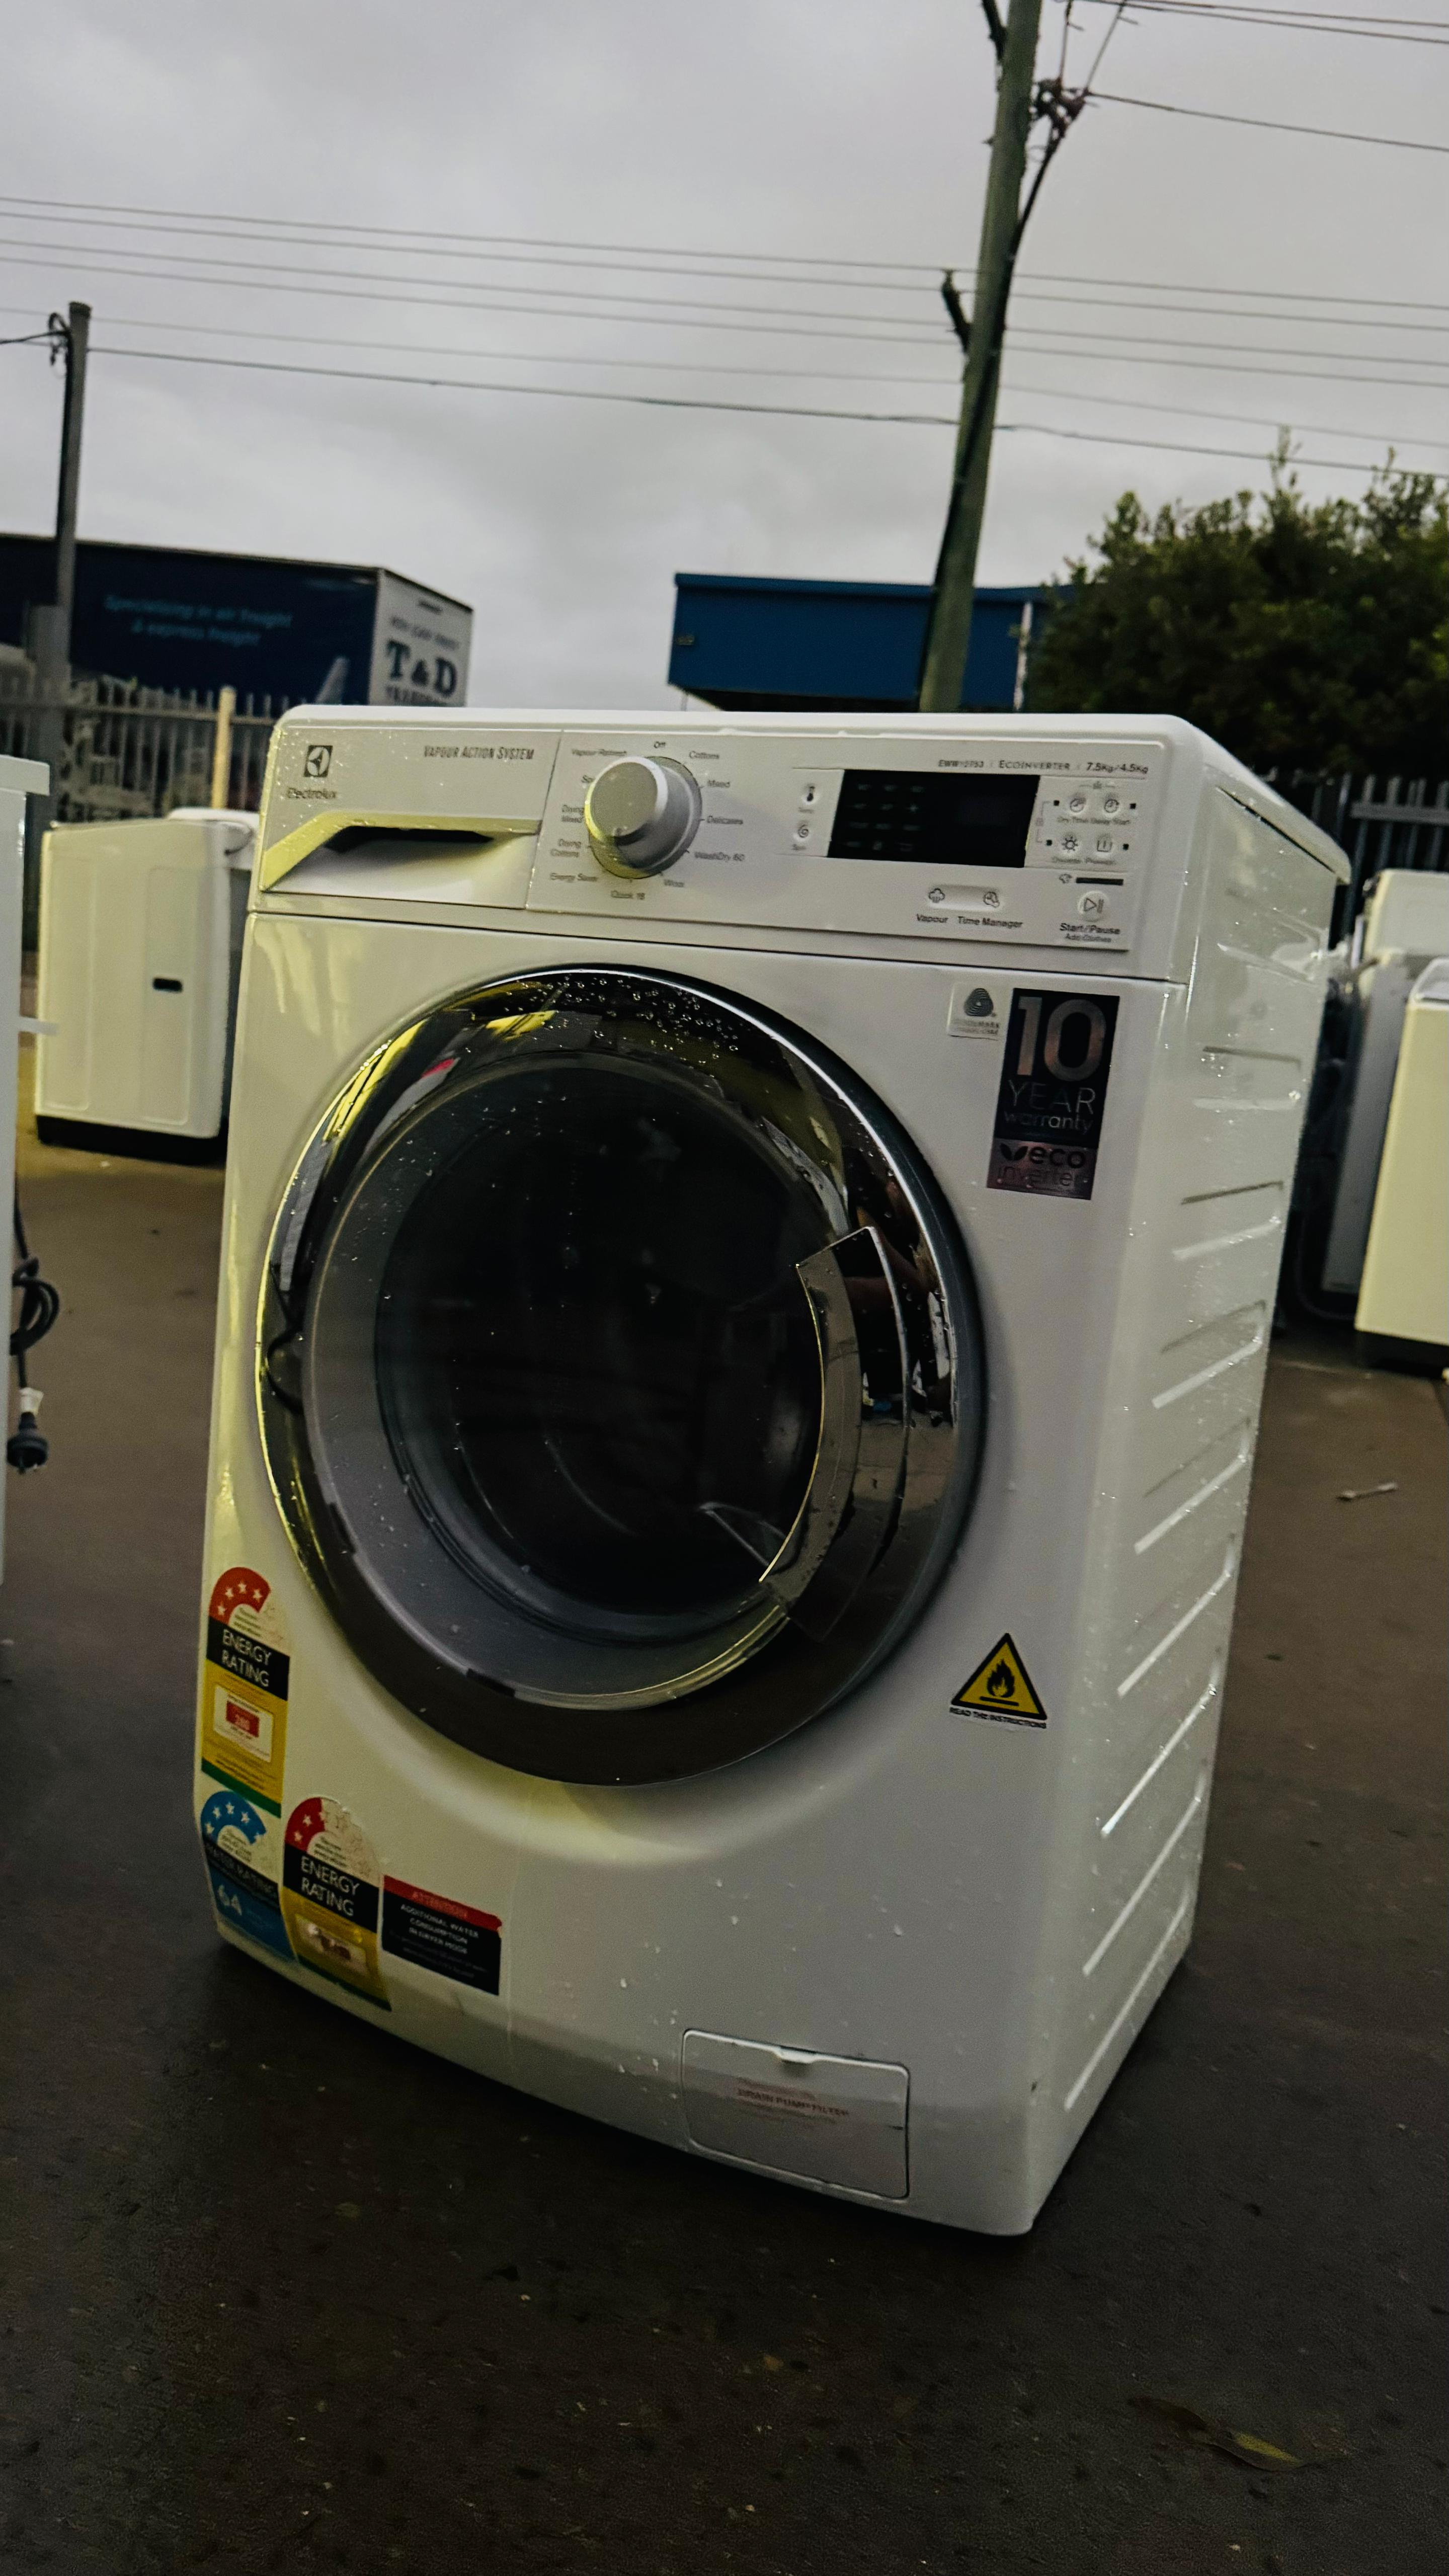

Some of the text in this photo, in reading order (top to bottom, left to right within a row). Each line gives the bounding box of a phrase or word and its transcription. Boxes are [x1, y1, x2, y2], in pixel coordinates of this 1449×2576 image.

[425, 746, 534, 760] VAPOUR ACTION SYSTEM
[689, 751, 719, 759] Cottons
[286, 788, 337, 799] Electrolux
[917, 914, 948, 924] Vapour
[958, 916, 1023, 929] Time Manager
[1060, 923, 1120, 935] Start/Pause
[1017, 996, 1106, 1081] 10
[1008, 1079, 1096, 1114] YEAR
[1004, 1111, 1094, 1135] warranty
[1028, 1147, 1085, 1168] eco
[222, 1628, 272, 1665] ENERGY
[221, 1649, 269, 1687] RATING
[950, 1708, 971, 1716] READ
[973, 1711, 988, 1719] THE
[301, 1856, 360, 1896] ENERGY
[301, 1877, 354, 1917] RATING
[400, 1903, 479, 1939] ADDITIONAL WATER
[409, 1917, 468, 1945] CONSUMPTION
